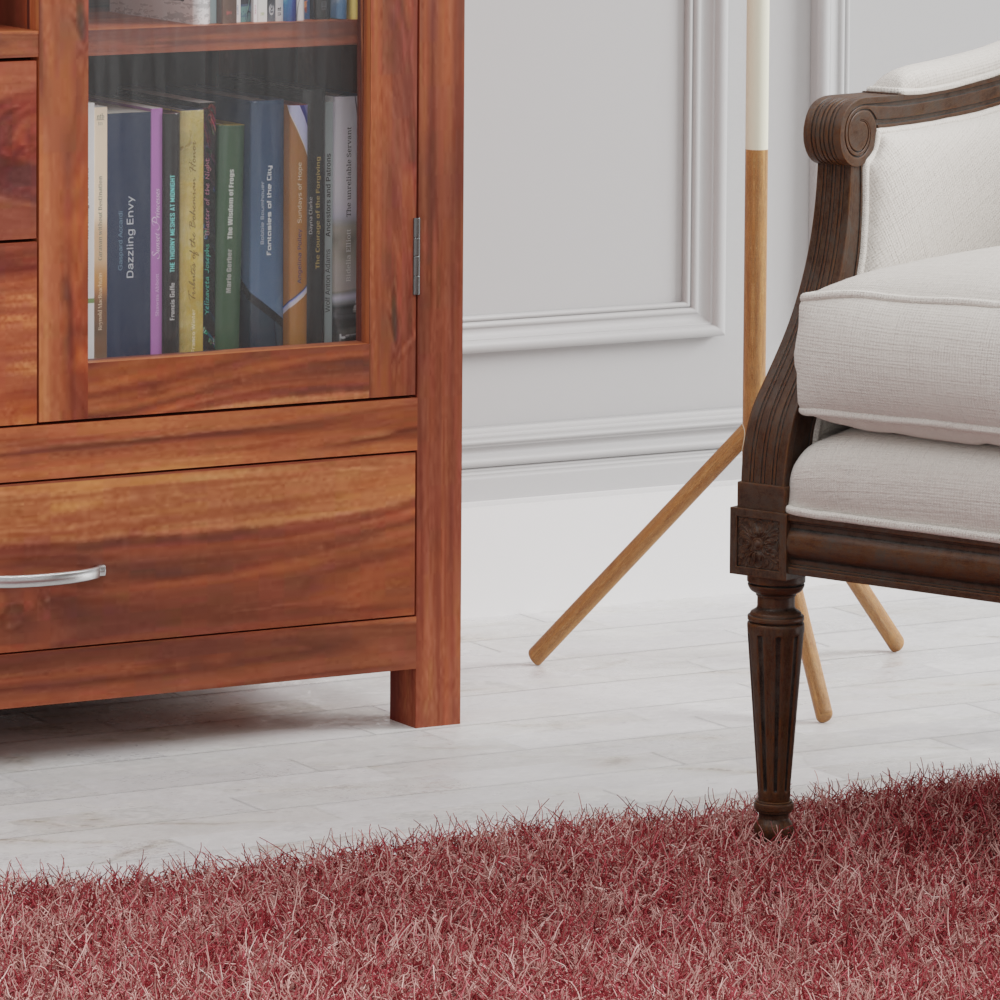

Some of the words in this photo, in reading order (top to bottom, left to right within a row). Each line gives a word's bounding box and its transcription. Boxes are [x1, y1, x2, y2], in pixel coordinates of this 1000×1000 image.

[189, 141, 197, 172] Honor
[204, 158, 212, 180] Night
[127, 196, 136, 225] Envy
[151, 189, 161, 231] Princesses
[170, 203, 175, 211] AT
[266, 200, 272, 208] of
[315, 210, 320, 218] of
[126, 228, 136, 278] Dazzling
[151, 233, 161, 259] Sunset
[188, 262, 196, 300] Tributes
